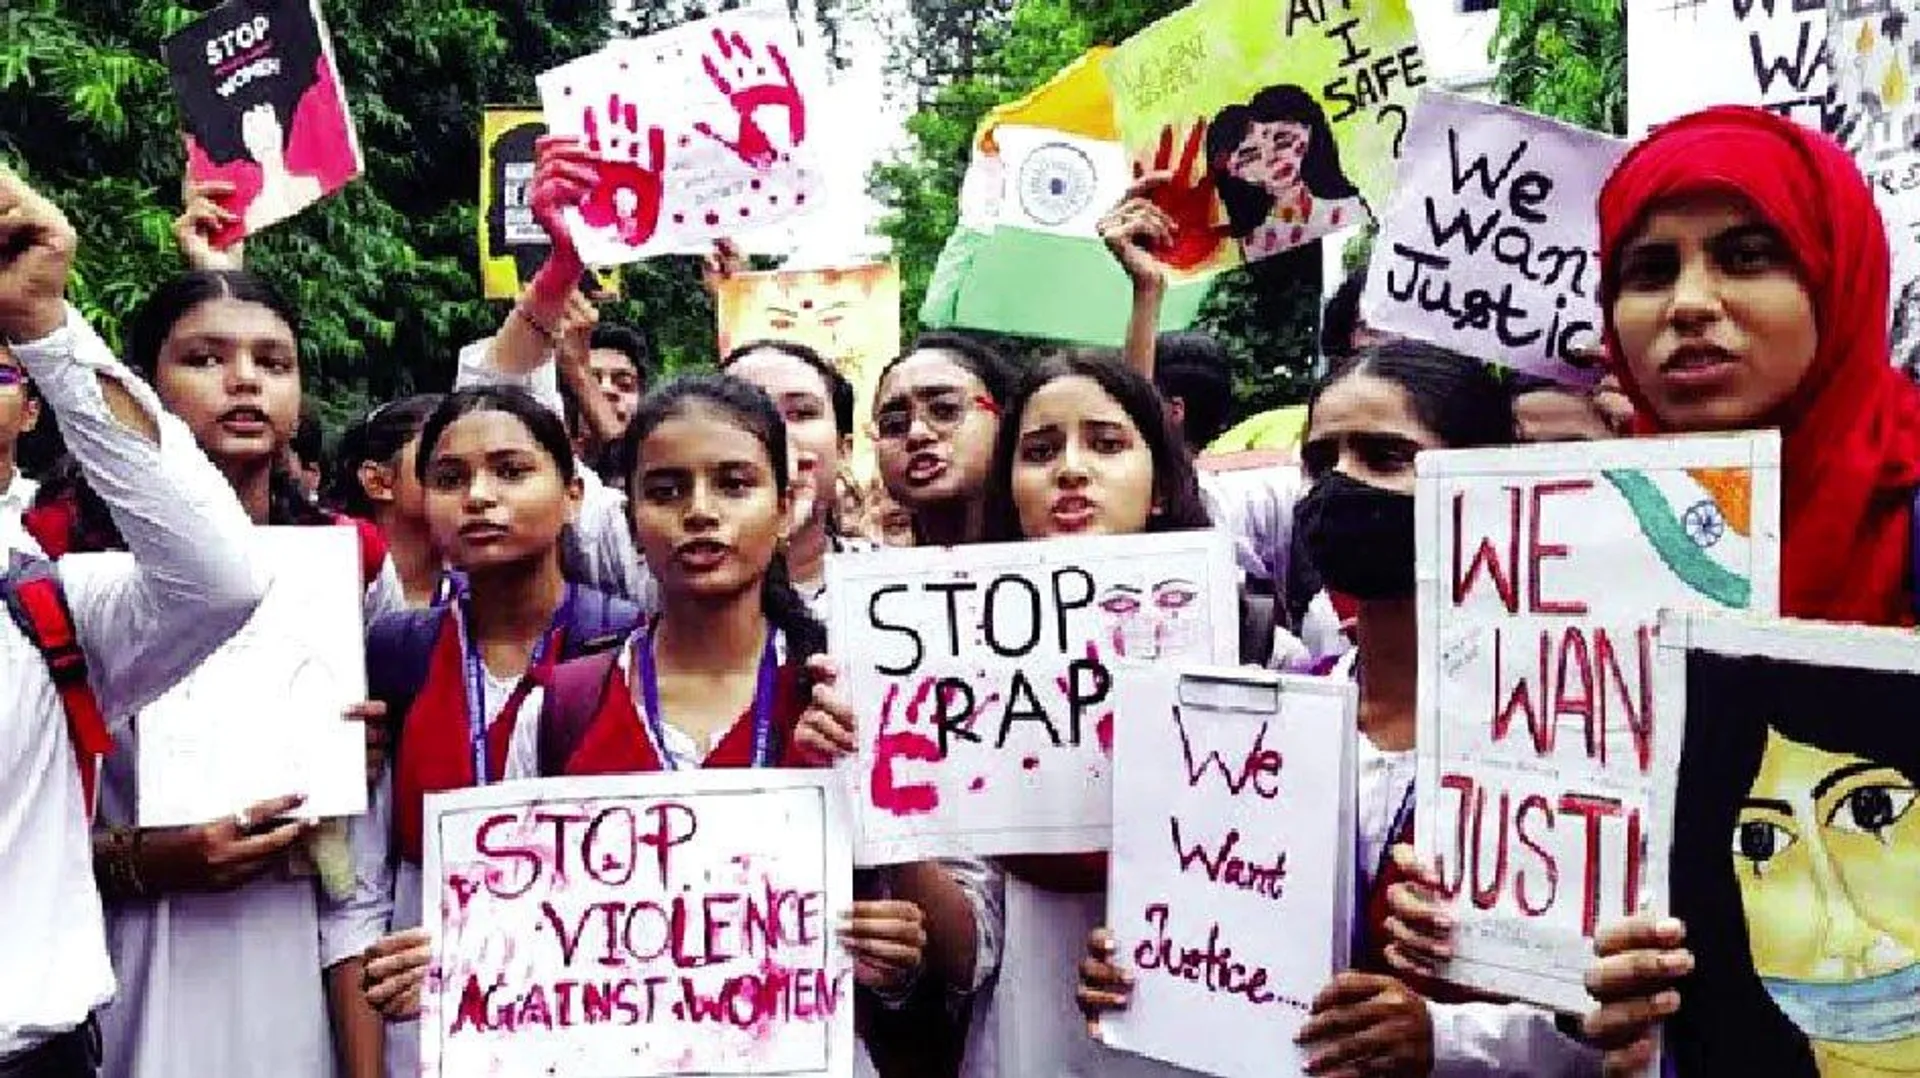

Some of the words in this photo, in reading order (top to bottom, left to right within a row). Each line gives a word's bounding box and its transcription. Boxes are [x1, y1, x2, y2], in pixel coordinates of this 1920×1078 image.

[206, 15, 270, 66] STOP
[1322, 45, 1427, 123] SAFE
[1324, 18, 1371, 67] I
[1376, 103, 1408, 160] ?
[1447, 127, 1553, 223] We
[1425, 195, 1601, 298] Wan
[1451, 478, 1594, 616] WE
[867, 565, 1096, 676] STOP
[935, 658, 1114, 759] RAP
[1491, 623, 1659, 773] WAN
[1171, 704, 1283, 800] We
[475, 803, 697, 900] STOP
[1169, 815, 1287, 901] Want
[541, 880, 822, 969] VIOLENCE
[449, 972, 669, 1038] AGAINST
[681, 966, 841, 1031] WOMEN
